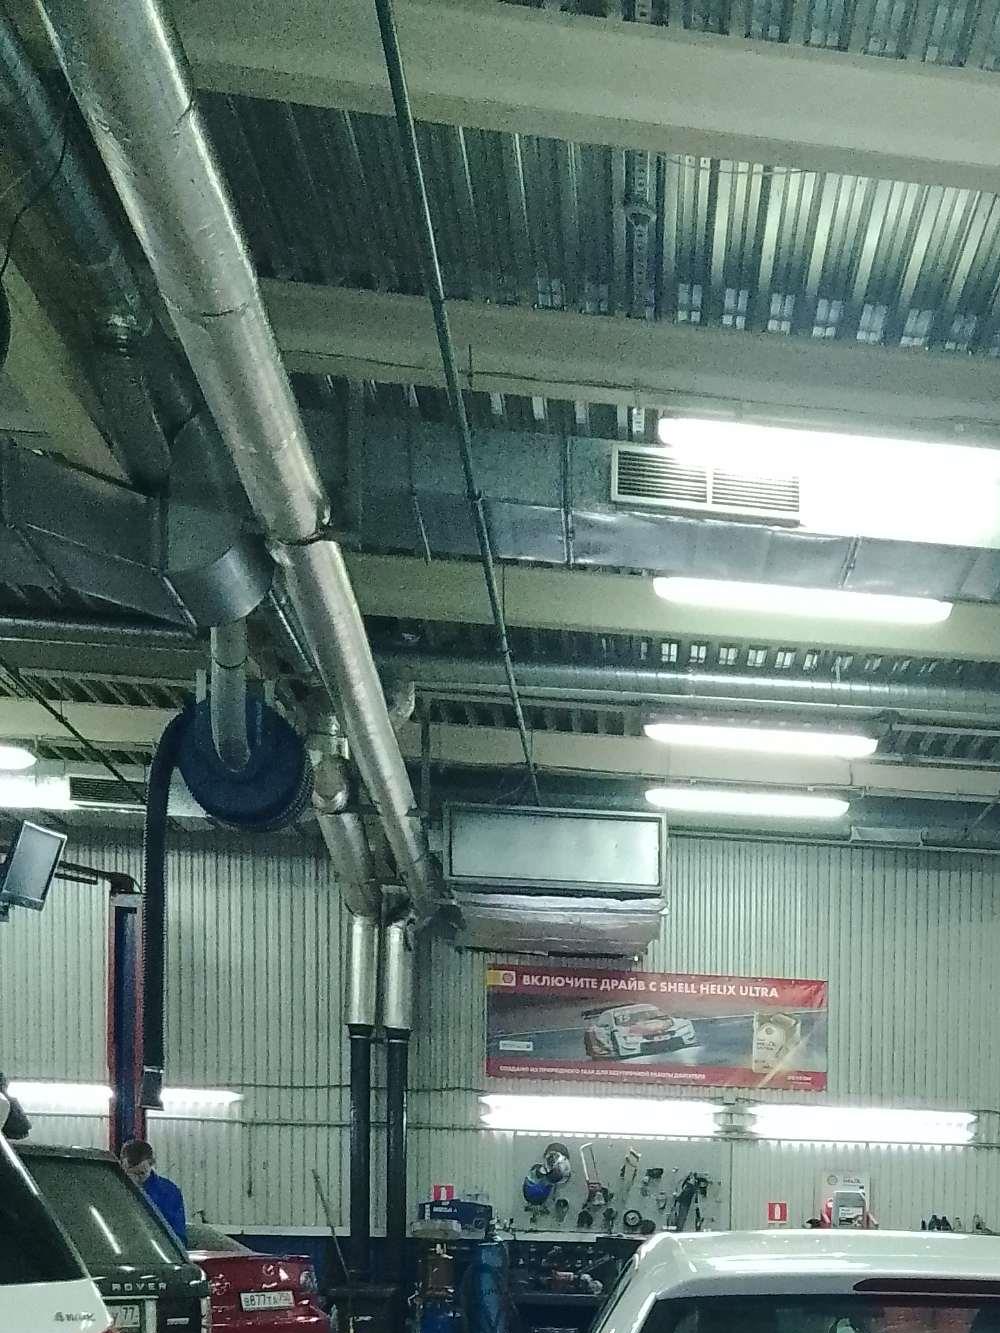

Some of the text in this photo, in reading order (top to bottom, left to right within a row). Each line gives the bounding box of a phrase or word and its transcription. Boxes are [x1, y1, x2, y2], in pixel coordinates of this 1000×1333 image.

[523, 974, 597, 989] ВКЛЮЧИТЕ
[600, 977, 646, 991] ДРАЙВ
[660, 981, 697, 994] SHELL
[700, 983, 736, 996] HELIX
[739, 985, 779, 998] ULTRA
[112, 1282, 167, 1292] ROVER
